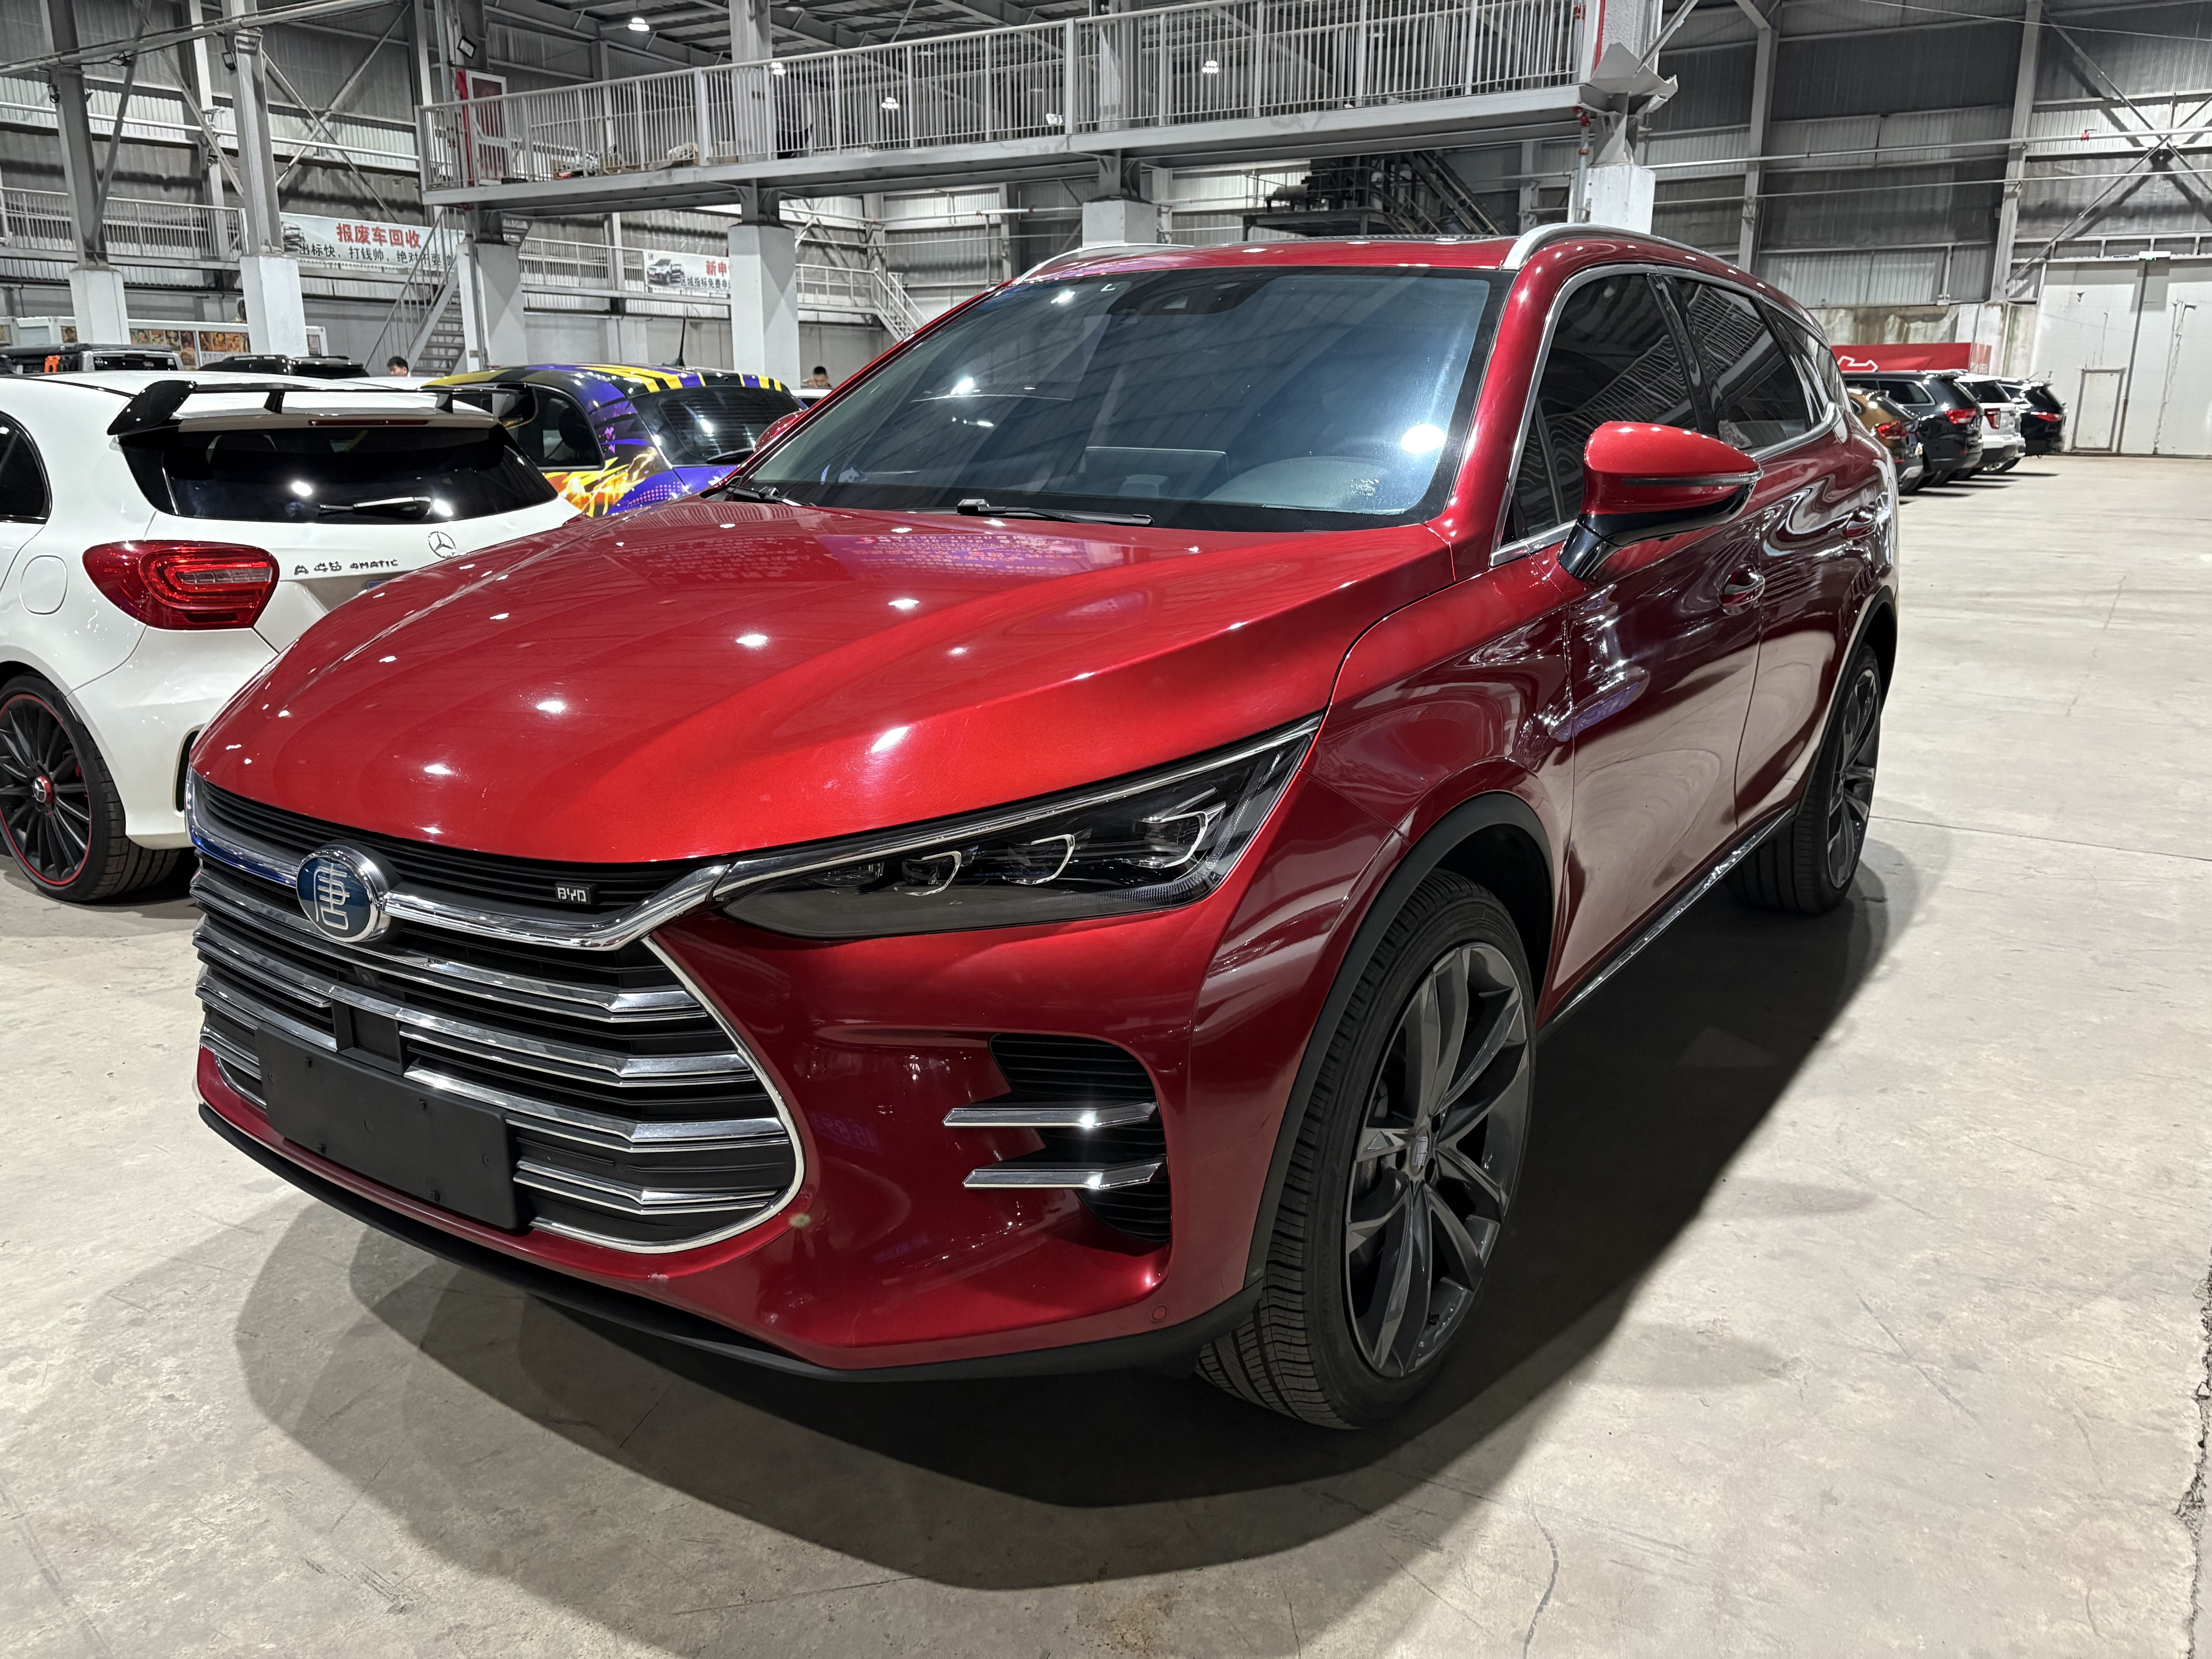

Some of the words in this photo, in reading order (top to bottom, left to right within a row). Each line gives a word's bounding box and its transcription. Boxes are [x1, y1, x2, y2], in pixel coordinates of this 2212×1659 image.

[336, 223, 421, 249] 报废车回收
[294, 564, 309, 575] A
[314, 560, 342, 572] 45
[349, 558, 399, 570] 4MATIC
[557, 887, 587, 902] BYD
